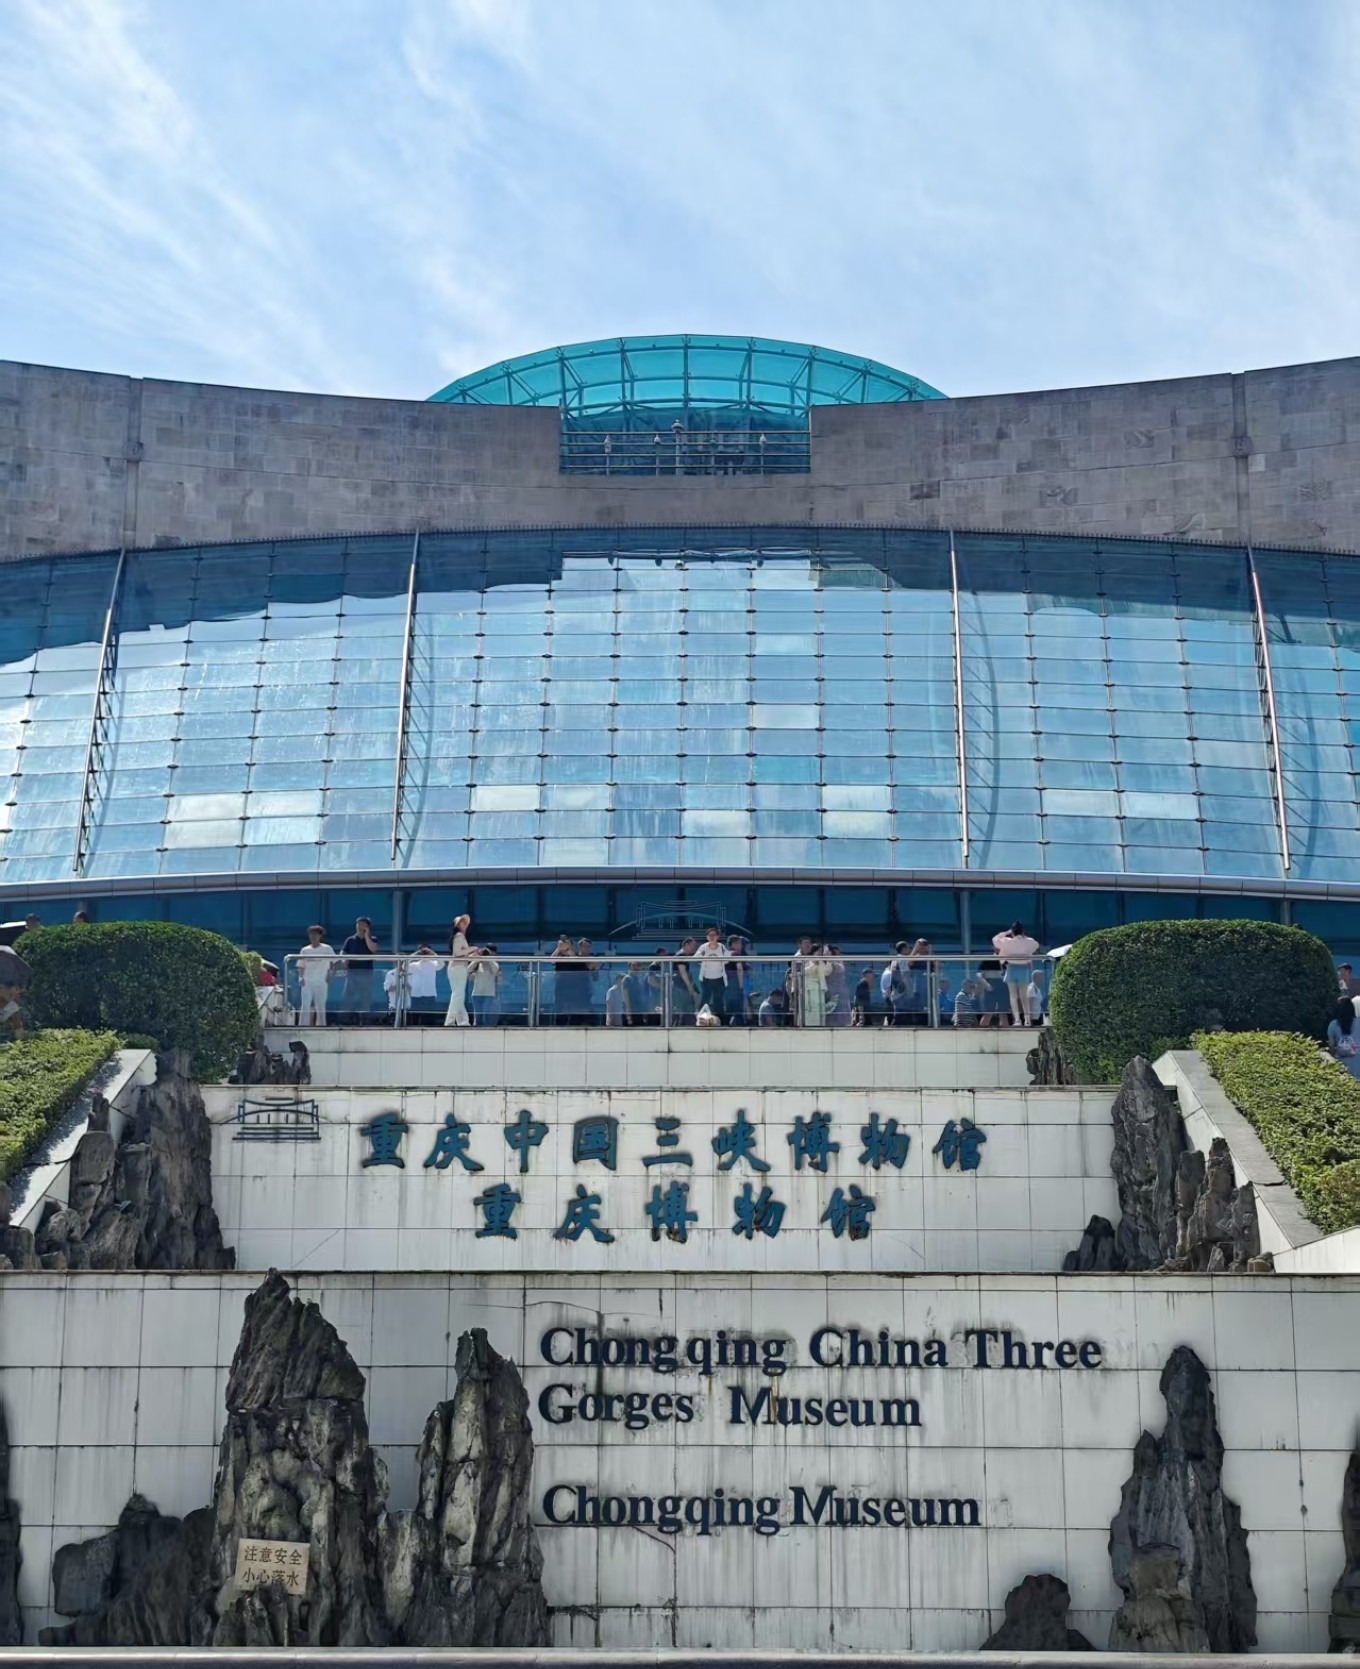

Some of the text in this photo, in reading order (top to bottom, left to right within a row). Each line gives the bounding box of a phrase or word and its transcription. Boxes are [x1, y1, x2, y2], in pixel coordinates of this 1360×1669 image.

[360, 1109, 987, 1173] 重庆中国三峡博物馆
[473, 1181, 876, 1243] 重庆博物馆
[540, 1327, 1102, 1376] Chongqing China Three
[538, 1383, 922, 1430] Gorges Museum
[542, 1485, 982, 1536] Chongqing Museum
[242, 1567, 300, 1587] 小心落水
[244, 1545, 302, 1565] 注意安全
